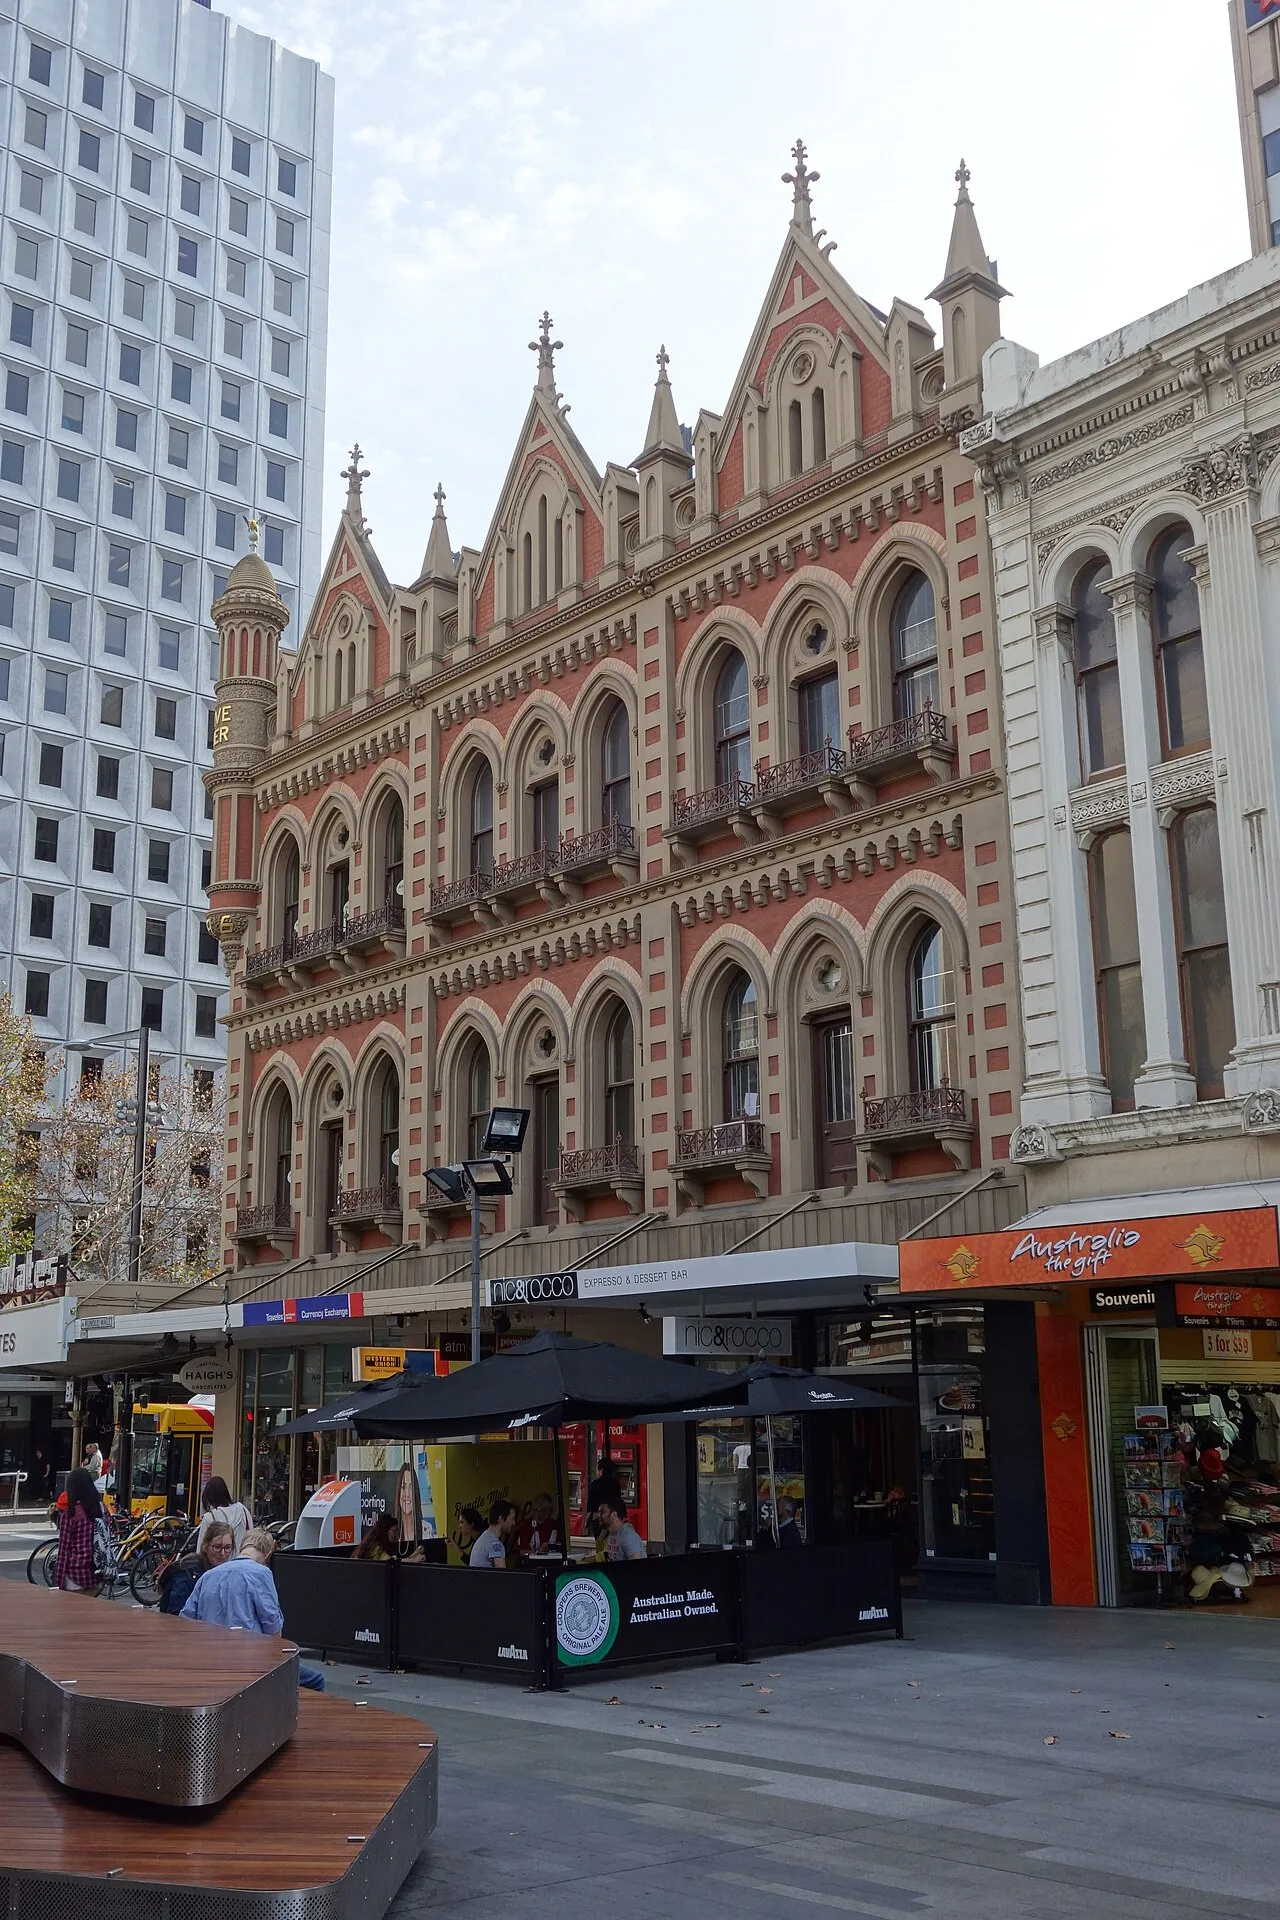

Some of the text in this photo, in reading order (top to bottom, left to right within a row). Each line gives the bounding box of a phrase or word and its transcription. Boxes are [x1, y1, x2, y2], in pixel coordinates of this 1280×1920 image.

[1010, 1227, 1141, 1261] Australia
[1044, 1248, 1112, 1277] the gift
[493, 1269, 688, 1304] nic&rocco EXPRESSO & DESSERT BAR
[1193, 1287, 1241, 1302] Australia
[301, 1310, 323, 1320] Currency
[325, 1308, 348, 1317] Exchange
[1207, 1300, 1232, 1314] the gift
[1184, 1316, 1209, 1325] Souvenirs
[685, 1321, 782, 1352] nic&rocco
[1207, 1334, 1248, 1353] 3 for $39
[445, 1340, 466, 1352] atm
[185, 1371, 233, 1380] HAIGH'S
[335, 1529, 353, 1542] City
[557, 1583, 604, 1627] COOPERS BREWERY
[632, 1588, 715, 1608] Australian Made.
[629, 1603, 719, 1624] Australian Owned.
[859, 1606, 889, 1620] LAVAZZA
[355, 1628, 380, 1643] LAVAZZA
[562, 1632, 592, 1650] ORIGINAL
[591, 1626, 606, 1645] PALE
[498, 1644, 528, 1660] LAVAZZA
